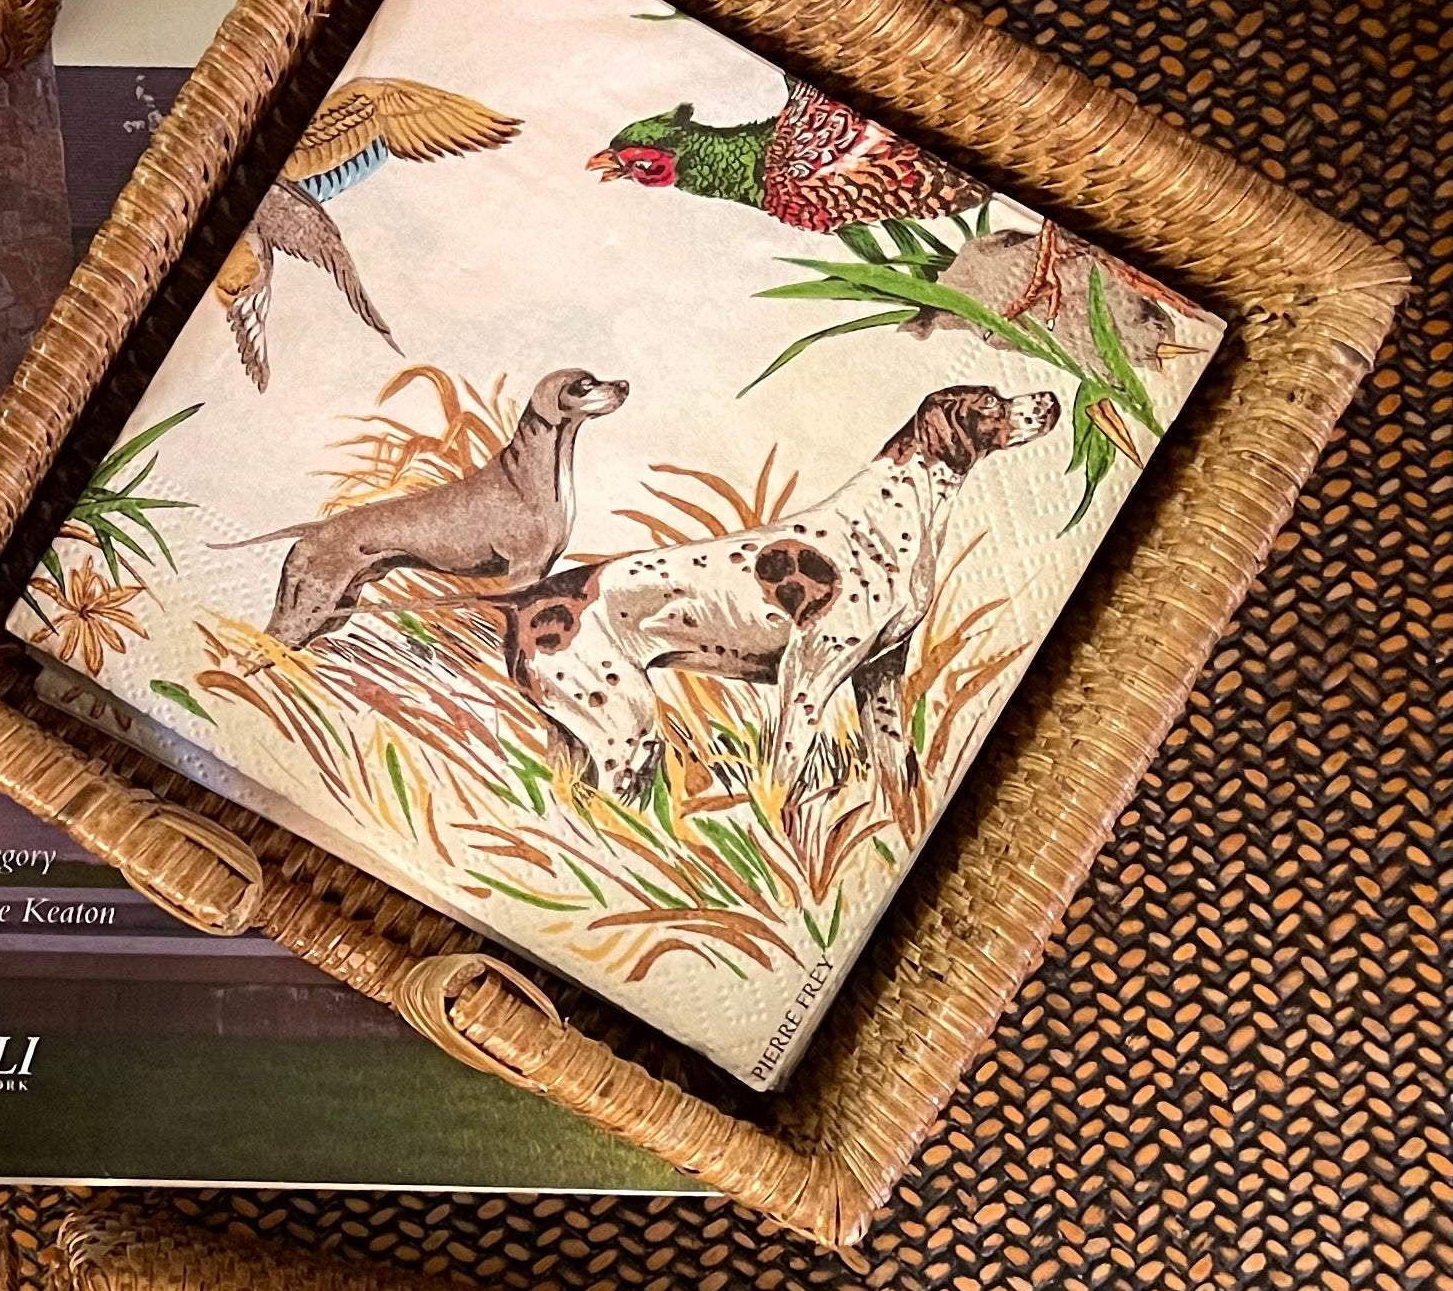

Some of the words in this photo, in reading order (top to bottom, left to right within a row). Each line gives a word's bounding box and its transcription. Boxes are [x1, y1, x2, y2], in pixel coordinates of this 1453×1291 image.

[21, 897, 116, 925] Keaton
[749, 1009, 804, 1082] PIERRE
[795, 954, 835, 1010] FREY
